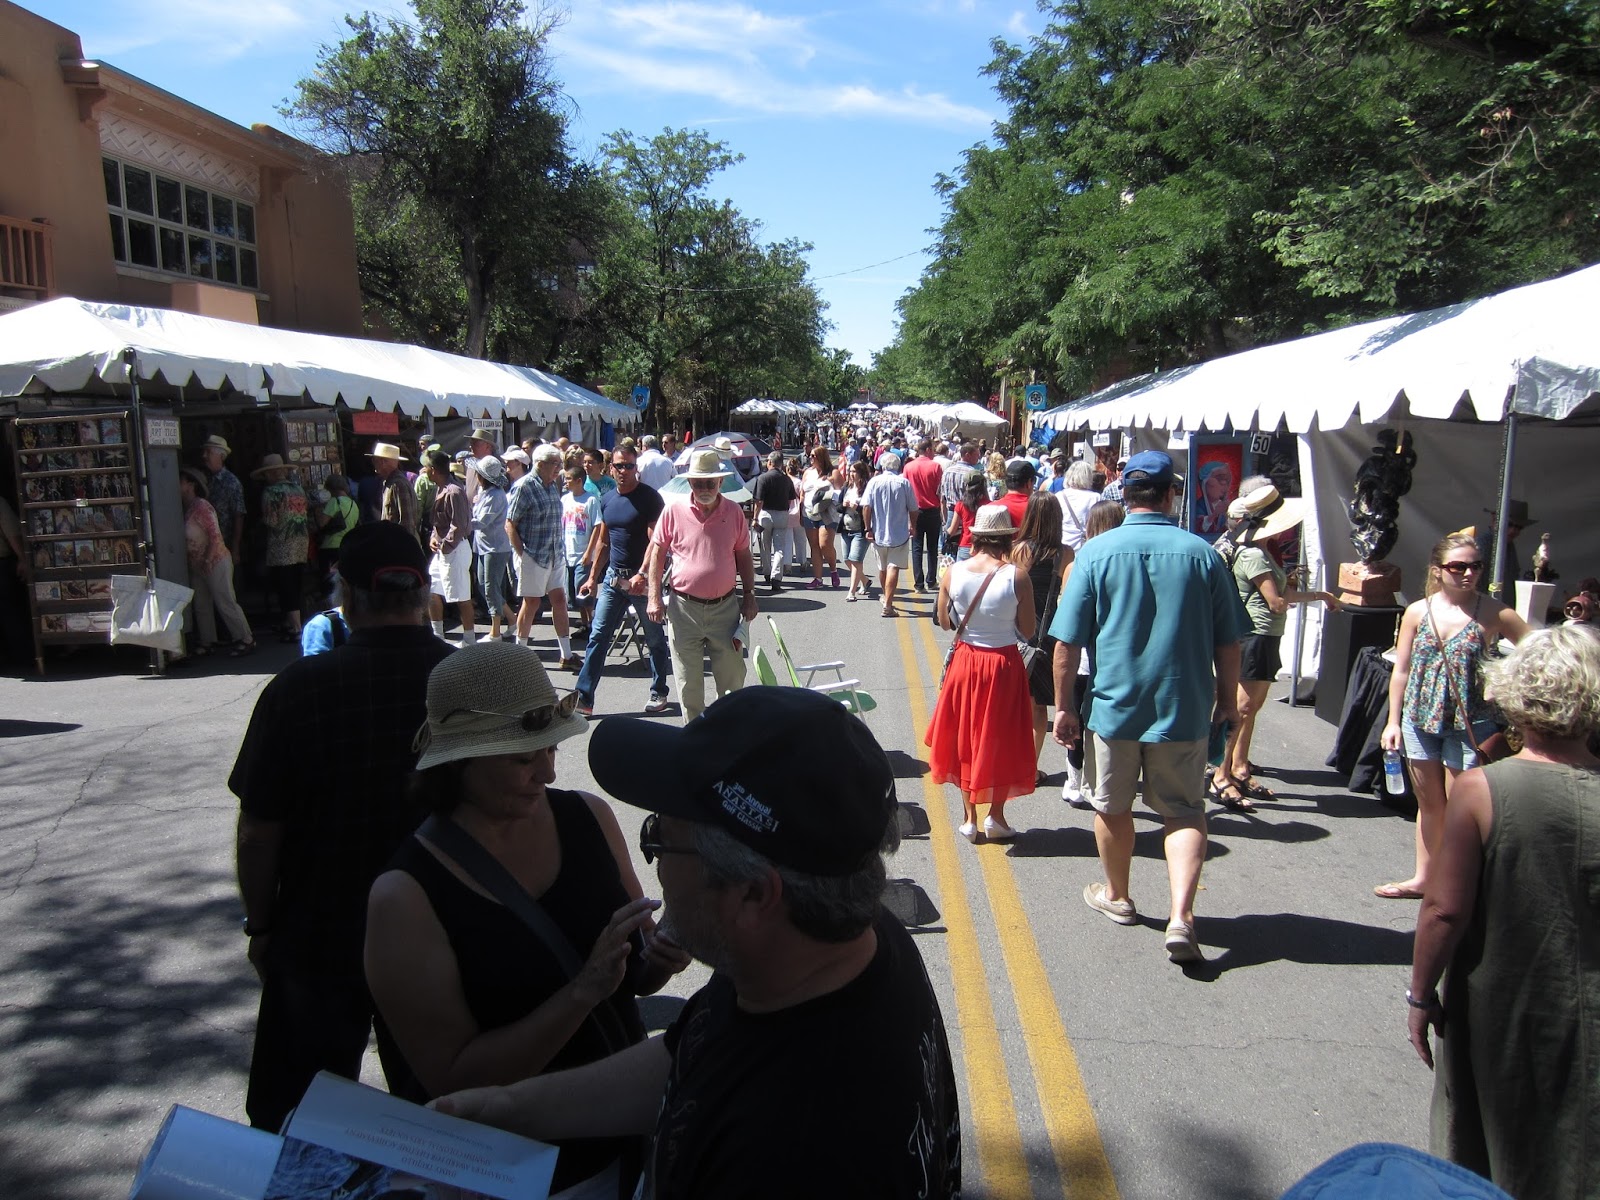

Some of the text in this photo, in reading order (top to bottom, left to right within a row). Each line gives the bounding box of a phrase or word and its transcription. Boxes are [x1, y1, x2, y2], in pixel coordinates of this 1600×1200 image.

[164, 428, 177, 437] TILE
[1253, 436, 1269, 452] 50
[712, 780, 779, 832] ANASTASI
[745, 793, 772, 815] Annual
[722, 799, 762, 832] Golf Classic
